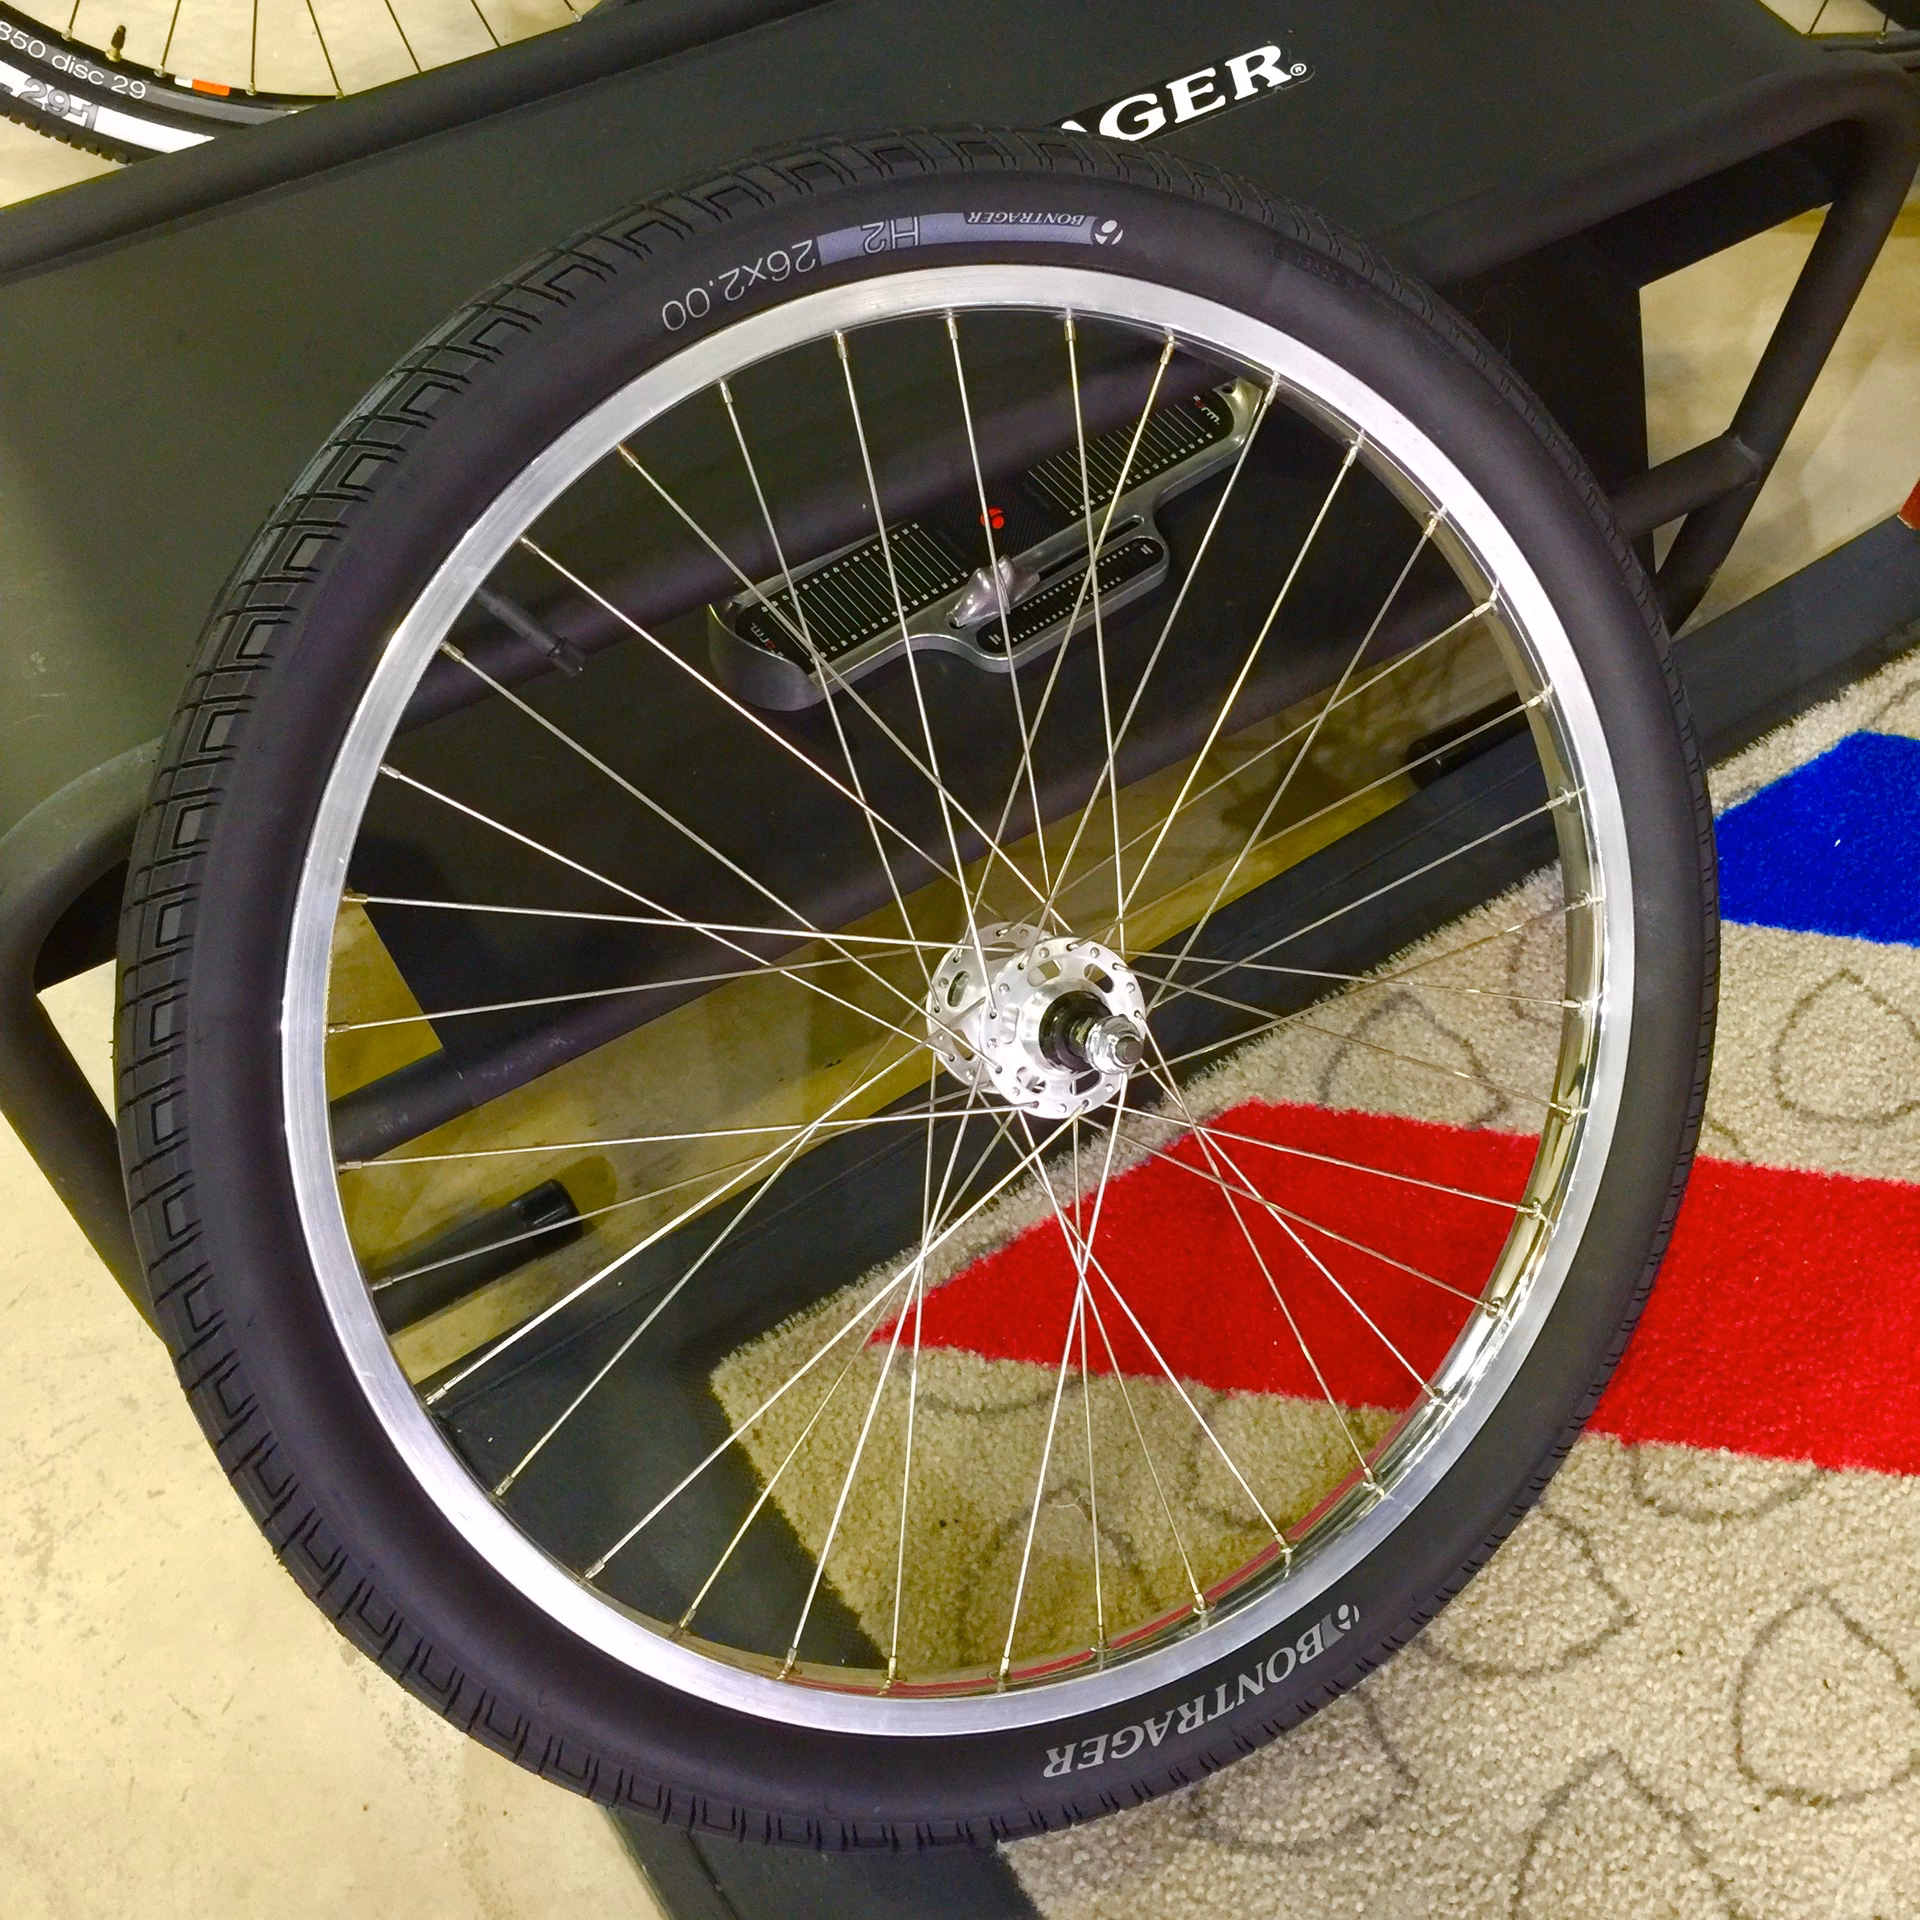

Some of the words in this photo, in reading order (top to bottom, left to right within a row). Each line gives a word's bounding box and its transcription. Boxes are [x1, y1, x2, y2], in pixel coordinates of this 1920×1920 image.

[0, 20, 46, 59] 850
[52, 55, 105, 86] disc
[111, 75, 147, 100] 29
[861, 215, 921, 255] H2
[967, 211, 1087, 227] BONTRAGER
[661, 239, 817, 332] 26x2.00
[1042, 1622, 1326, 1779] BONTRAGER
